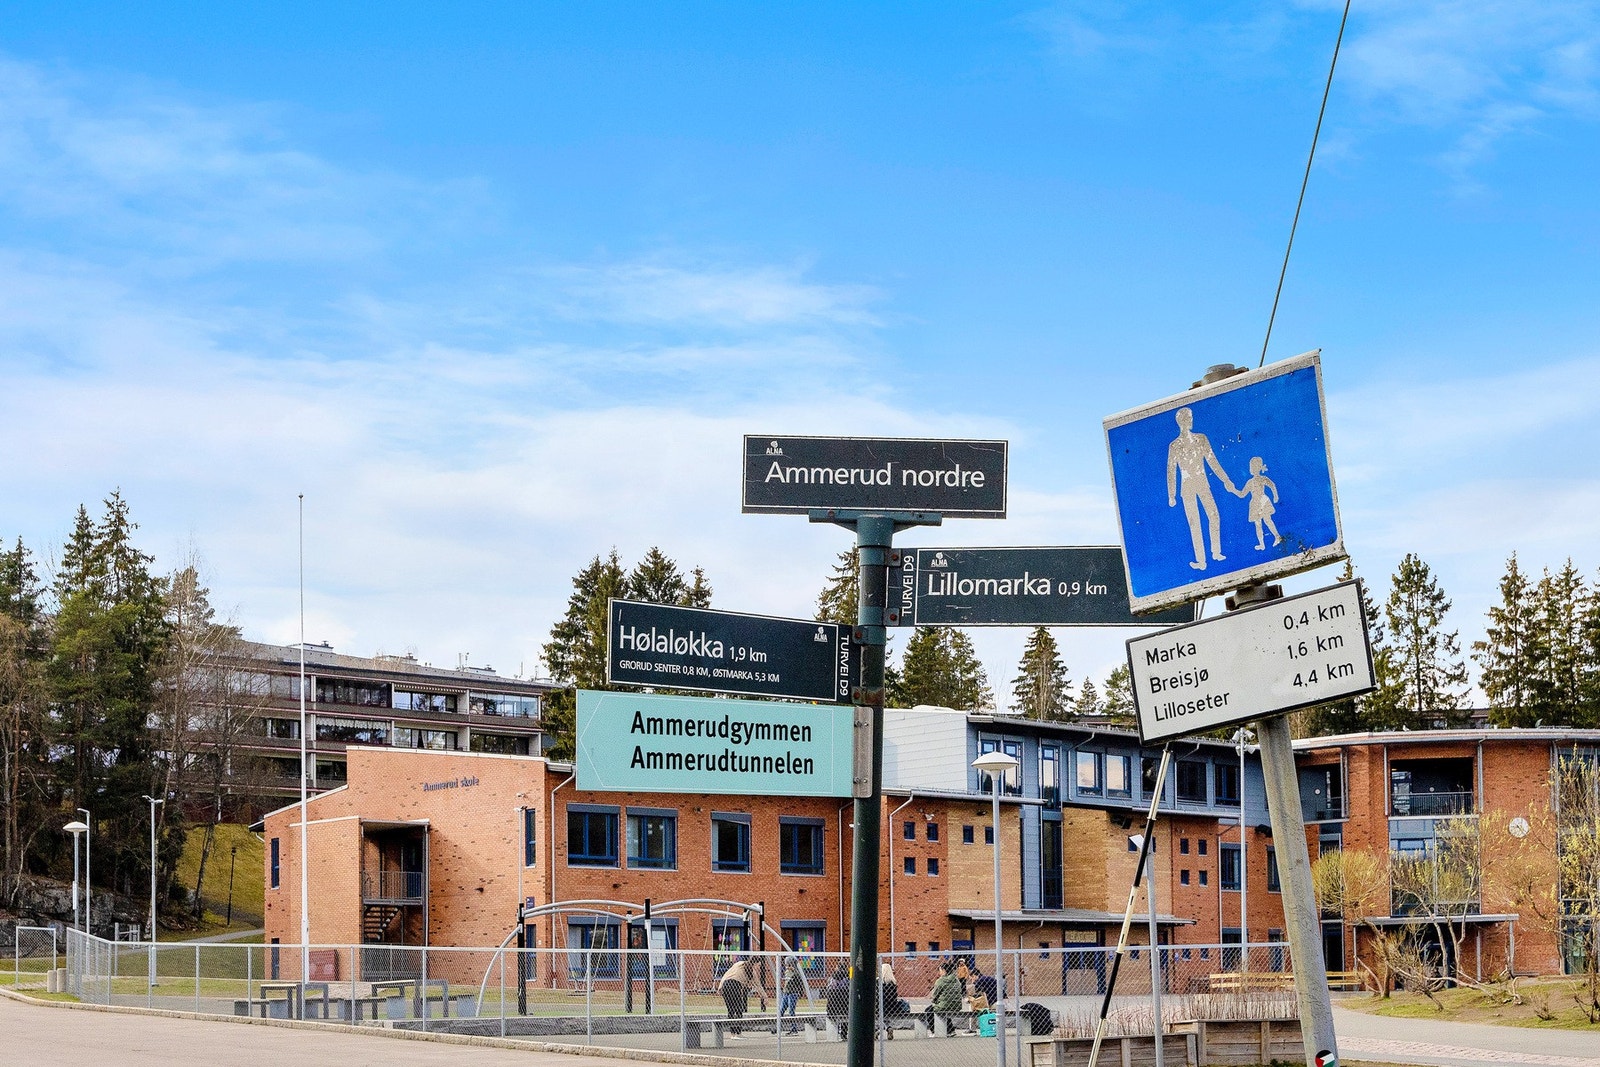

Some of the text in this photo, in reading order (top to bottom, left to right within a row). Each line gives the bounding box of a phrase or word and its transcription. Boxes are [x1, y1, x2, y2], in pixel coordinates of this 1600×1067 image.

[766, 447, 783, 455] ALNA
[764, 461, 985, 488] Ammerud nordre
[930, 559, 948, 567] ALNA
[901, 555, 914, 617] TURVEI D9
[928, 571, 1107, 597] Lillomarka 0,9 km
[619, 625, 767, 663] Hølaløkka 1,9 km
[1145, 604, 1345, 666] Marka 0,4 km
[619, 659, 780, 683] GRORUD SENTER 0,8 KM, ØSTMARKA 5,3 KM
[840, 634, 850, 696] TURVEI D9
[1149, 634, 1344, 694] Breisjø 1,6 km
[1154, 662, 1354, 722] Lilloseter 4,4 km
[630, 710, 812, 746] Ammerudgymmen
[630, 745, 814, 775] Ammerudtunnelen
[423, 775, 480, 792] Ammerud skole
